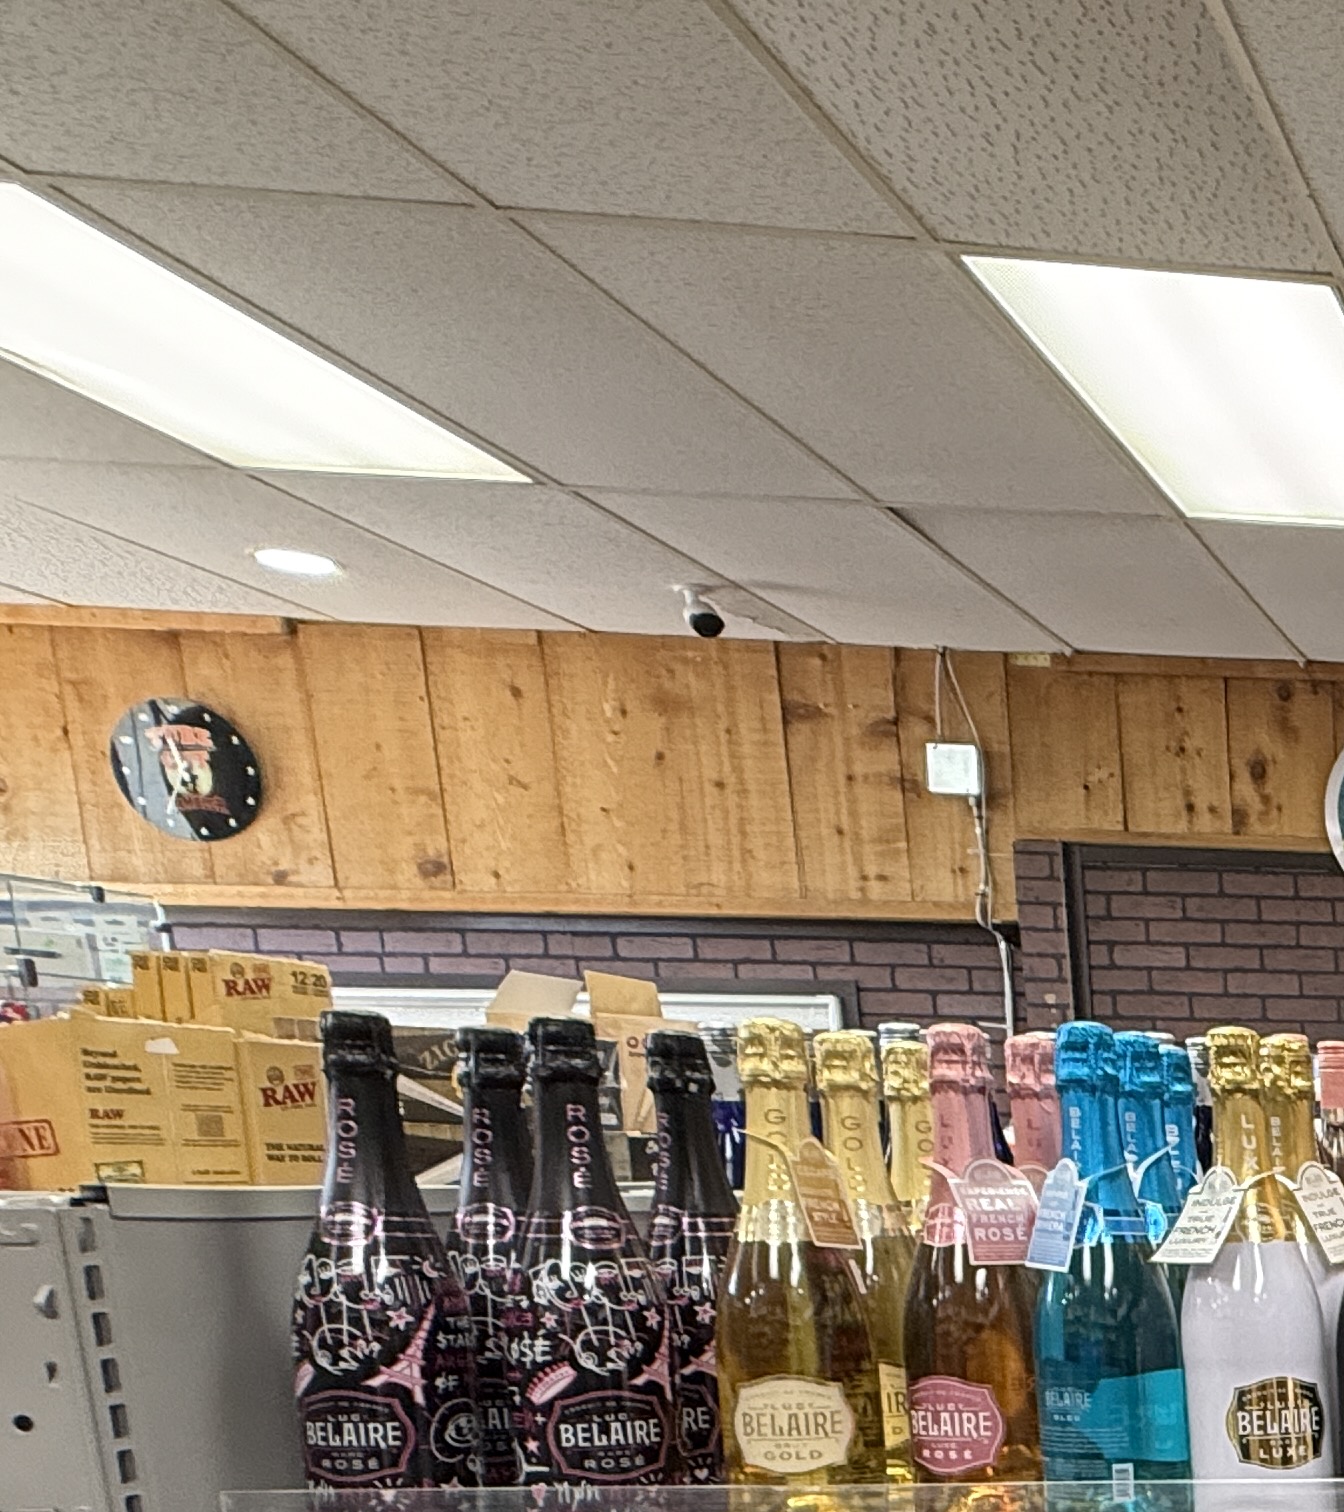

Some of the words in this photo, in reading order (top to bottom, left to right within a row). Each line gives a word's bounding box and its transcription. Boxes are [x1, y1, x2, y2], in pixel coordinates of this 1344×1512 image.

[222, 978, 273, 998] RAW
[259, 1081, 319, 1109] RAW
[89, 1109, 125, 1120] RAW
[336, 1098, 357, 1184] ROSE
[472, 1108, 494, 1188] ROSE
[965, 1197, 1023, 1213] REAL
[973, 1224, 1029, 1243] ROSÉ
[304, 1420, 402, 1448] BELAIRE
[558, 1419, 662, 1448] BELAIRE
[740, 1410, 844, 1439] BELAIRE
[910, 1409, 993, 1438] BELAIRE
[1236, 1407, 1321, 1437] BELAIRE
[583, 1453, 647, 1470] ROSÉ
[763, 1448, 825, 1464] GOLD
[1257, 1447, 1310, 1460] LUXE
